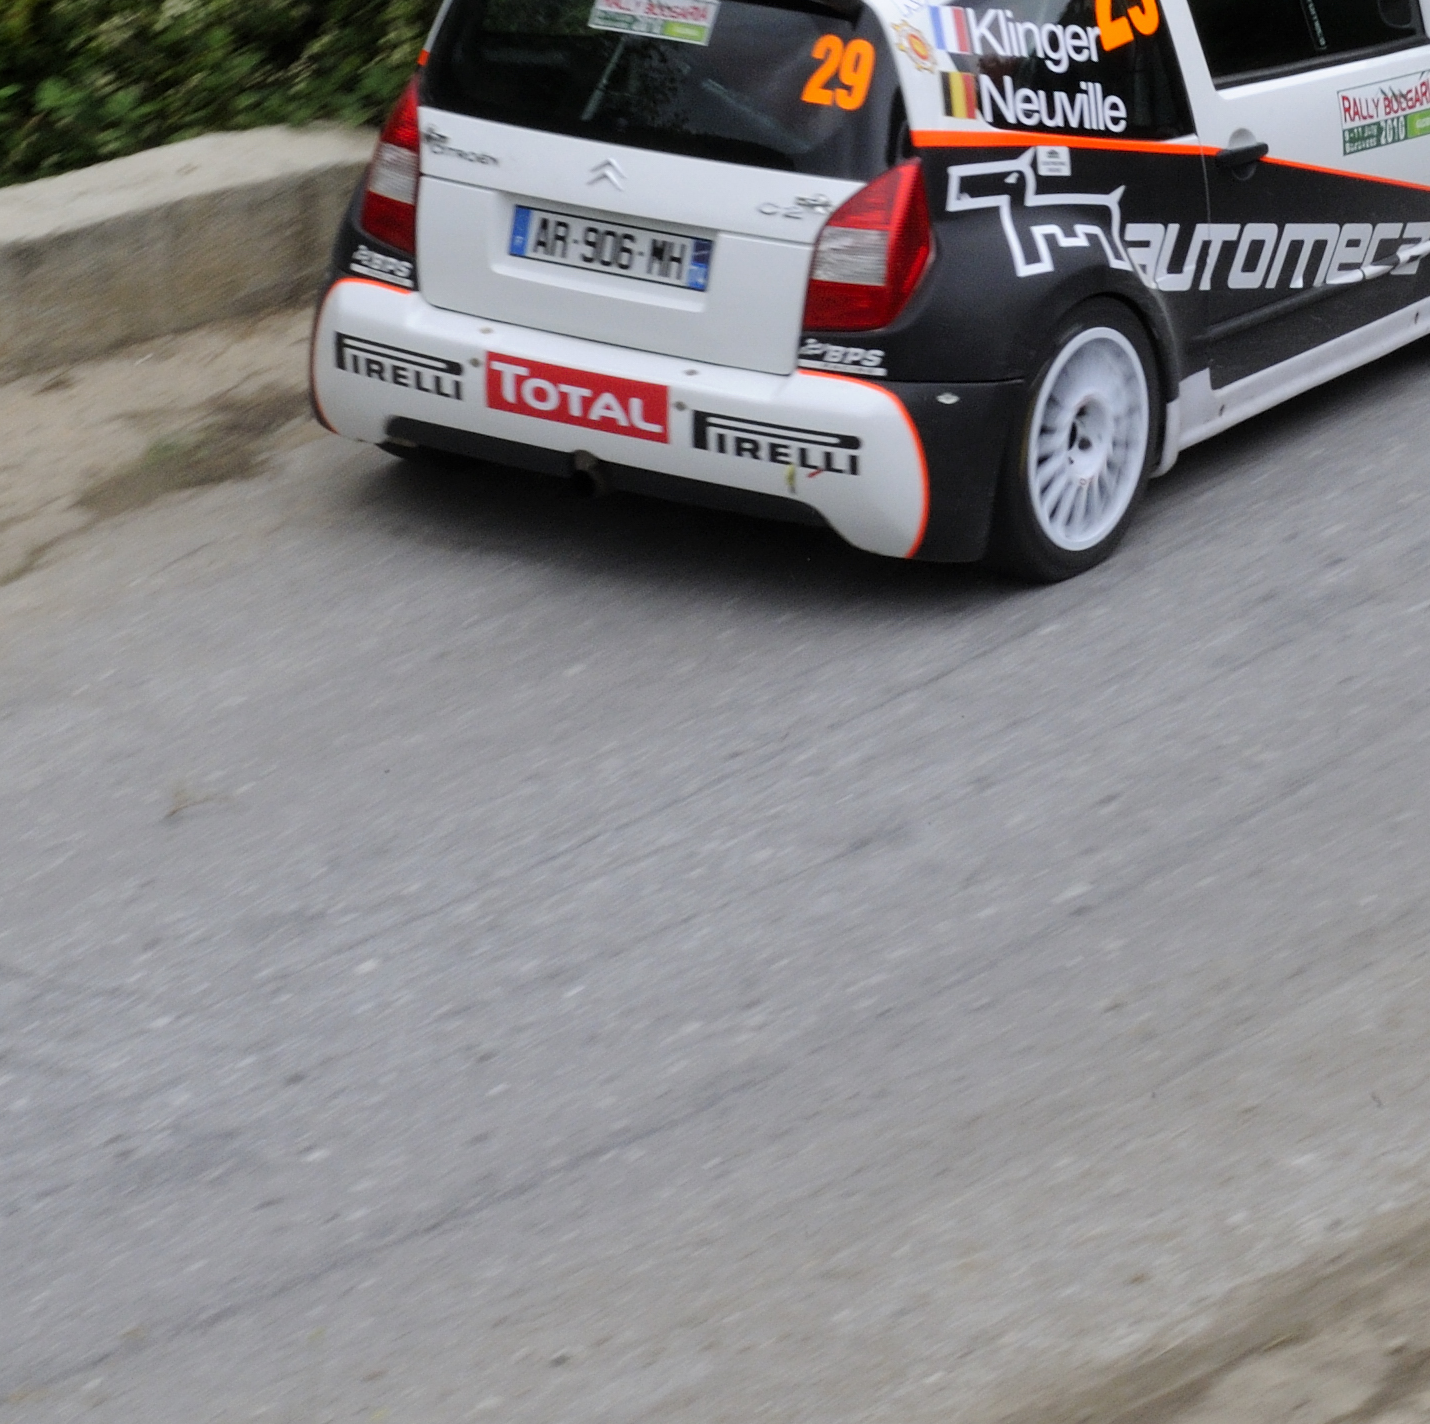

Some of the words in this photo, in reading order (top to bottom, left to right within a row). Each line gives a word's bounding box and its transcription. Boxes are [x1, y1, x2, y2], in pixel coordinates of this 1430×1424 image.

[800, 33, 876, 111] 29
[966, 7, 1101, 74] Klinger
[978, 73, 1128, 133] Neuville
[1341, 94, 1380, 123] RALLY
[1379, 116, 1406, 145] 2010
[335, 330, 463, 400] PIRELLI
[489, 360, 664, 433] TOTAL
[692, 409, 862, 476] PIRELLI
